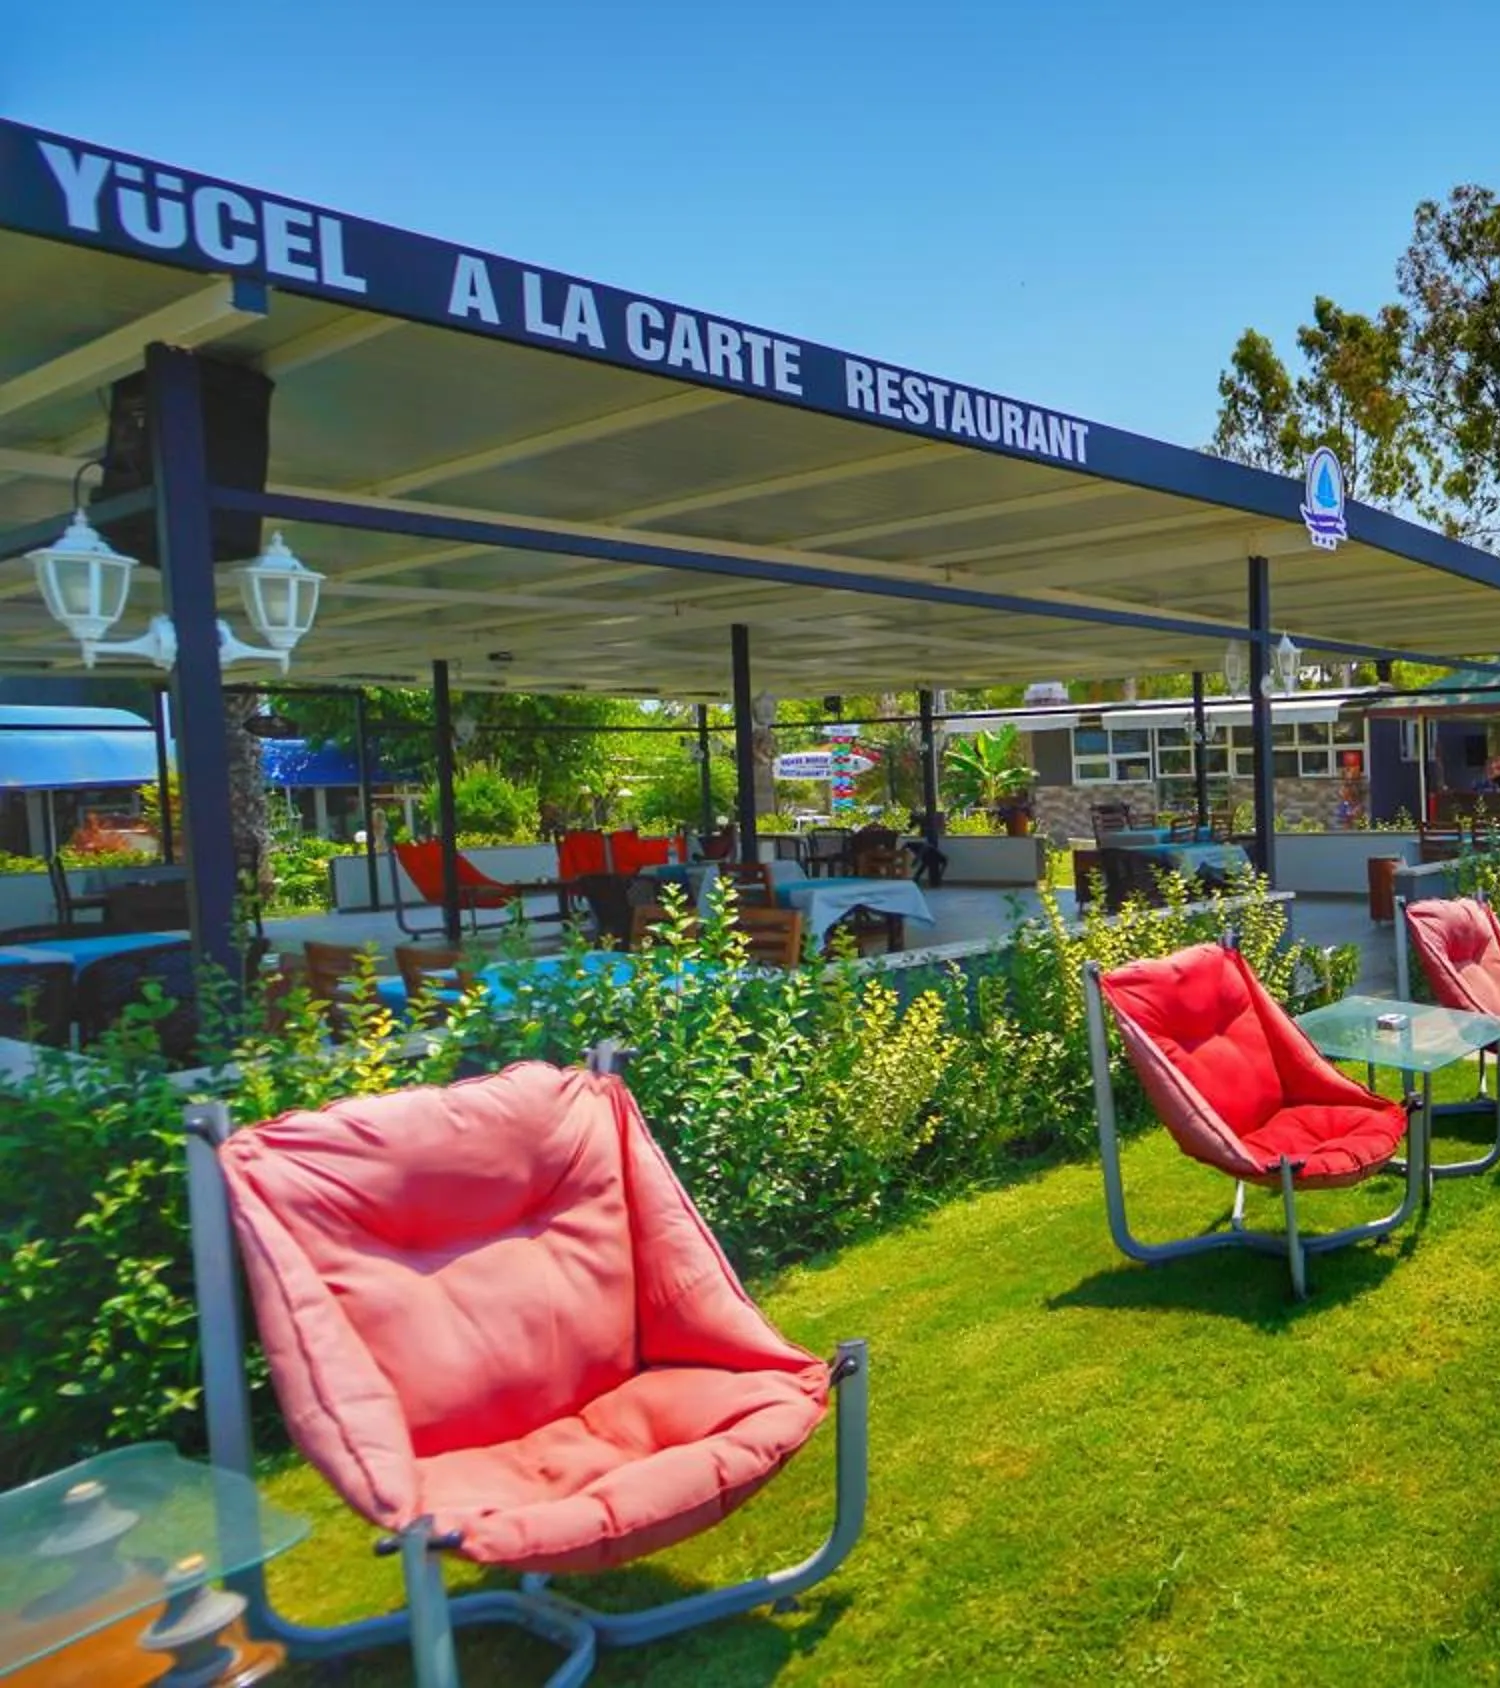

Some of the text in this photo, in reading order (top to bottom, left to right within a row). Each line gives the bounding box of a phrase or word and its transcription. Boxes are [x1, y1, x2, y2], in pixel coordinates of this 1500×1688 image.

[36, 138, 1090, 464] YÜCEL A LA CARTE RESTAURANT
